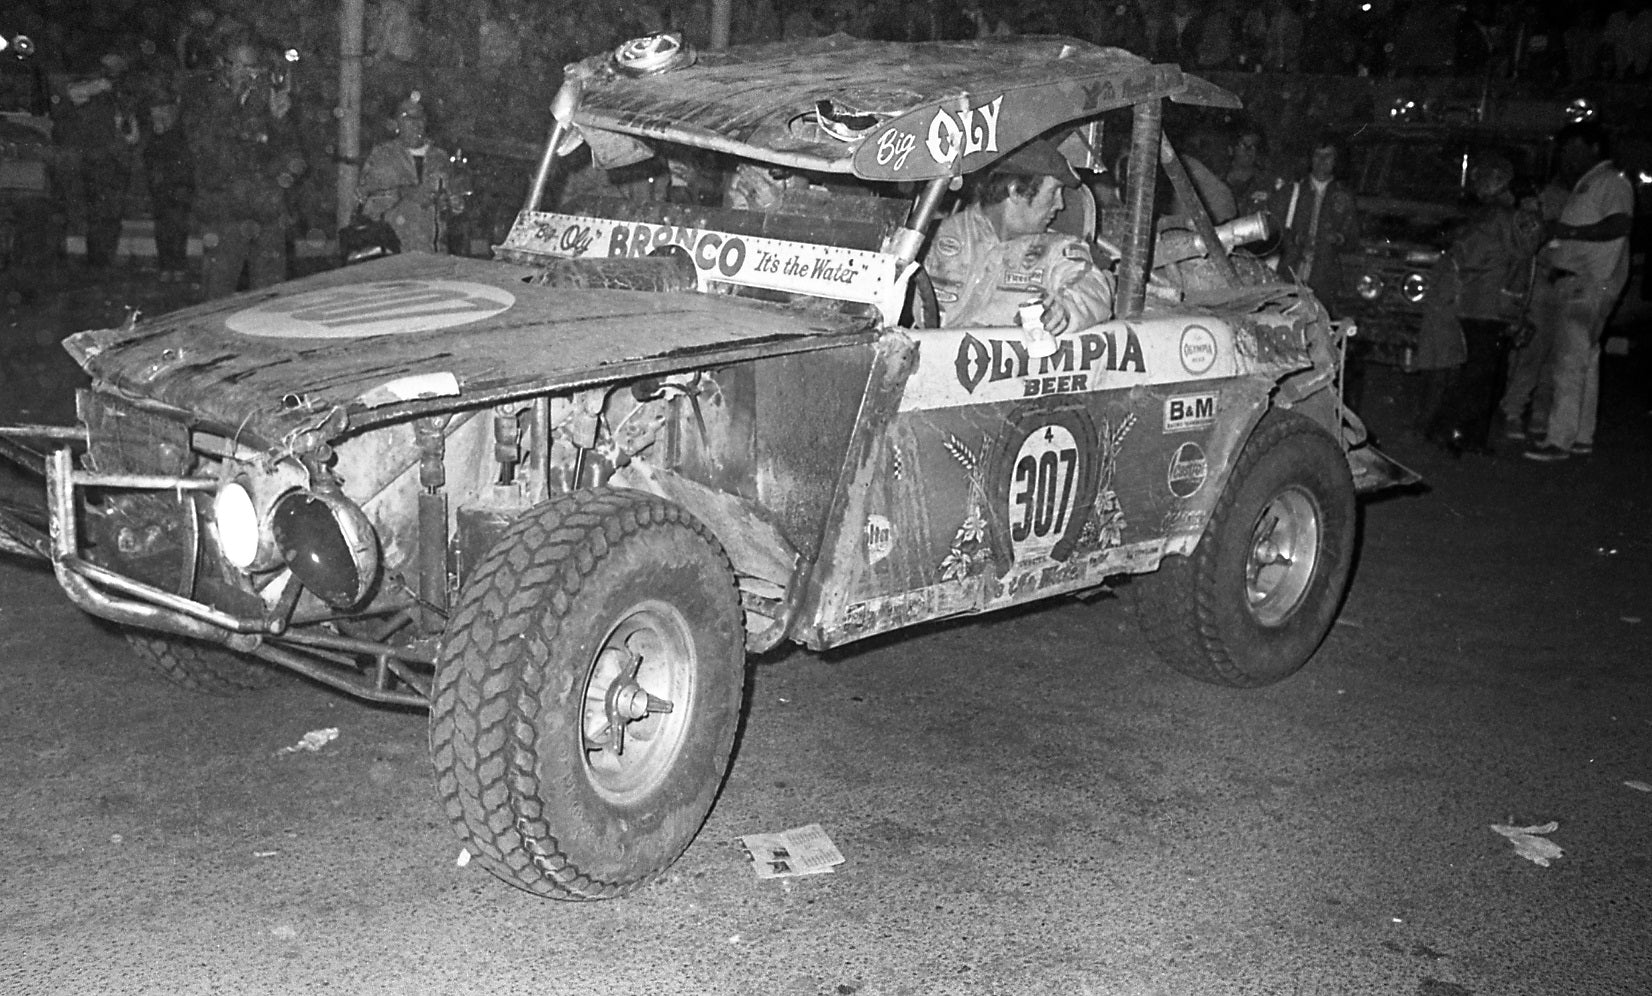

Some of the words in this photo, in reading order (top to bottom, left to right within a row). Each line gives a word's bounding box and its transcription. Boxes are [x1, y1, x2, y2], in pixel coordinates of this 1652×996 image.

[877, 128, 916, 171] Big
[926, 94, 1004, 166] OLY
[608, 225, 746, 277] BRONCO
[783, 256, 809, 277] the
[954, 325, 1146, 395] OLYMPIA
[1023, 374, 1088, 397] BEER
[1044, 426, 1054, 443] 4
[1170, 397, 1213, 421] B&M
[1012, 448, 1077, 542] 307
